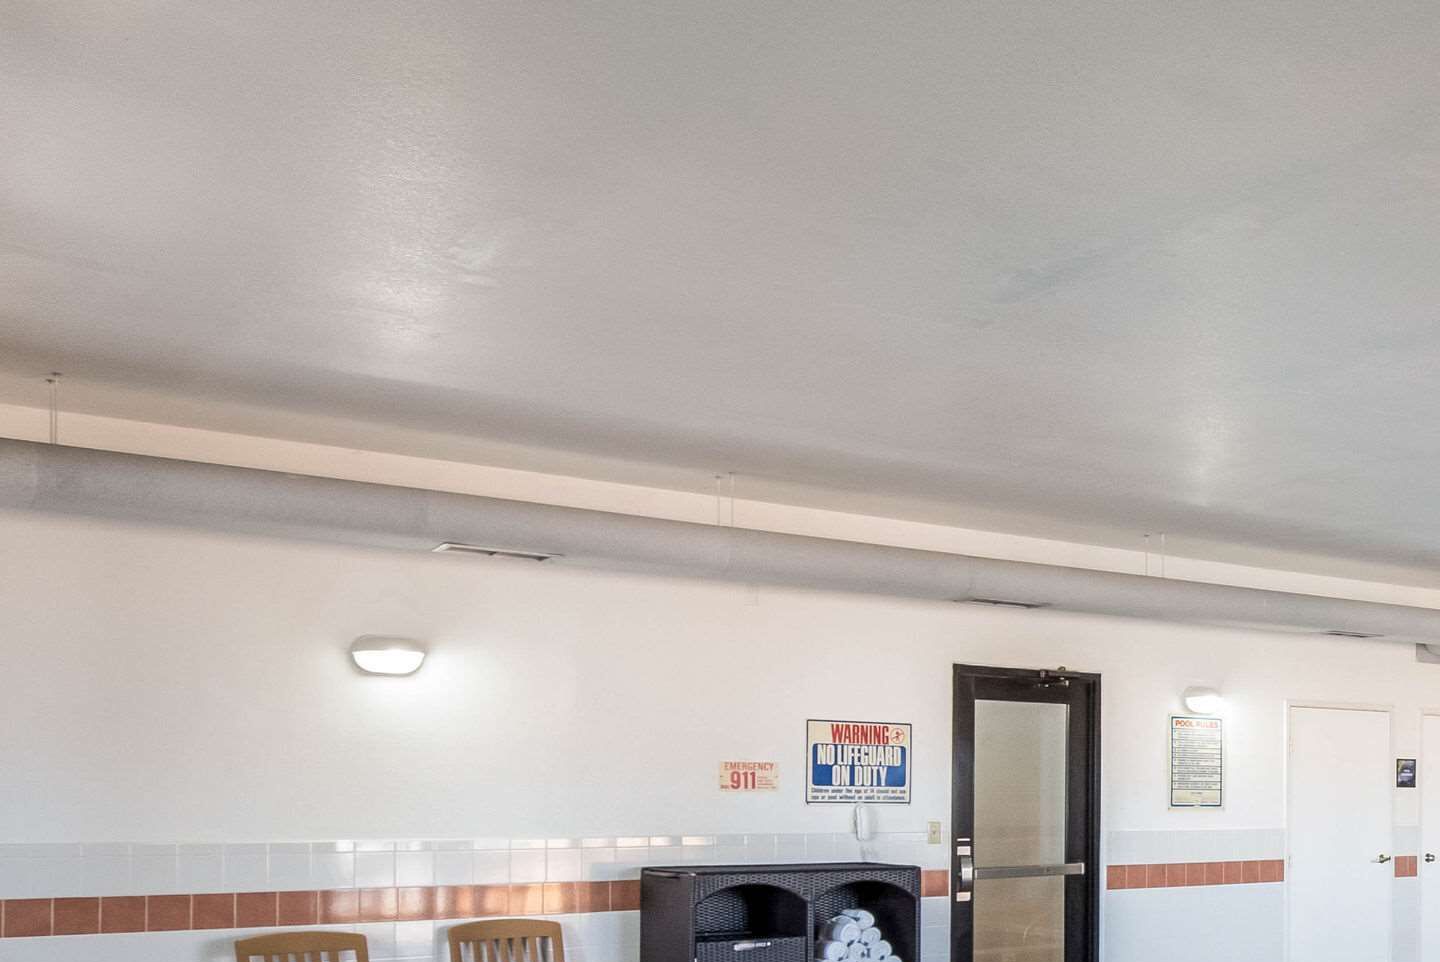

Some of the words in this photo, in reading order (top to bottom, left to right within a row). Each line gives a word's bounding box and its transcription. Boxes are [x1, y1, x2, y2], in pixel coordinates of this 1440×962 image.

[831, 723, 889, 745] WARNING
[817, 744, 835, 765] NO
[837, 744, 901, 767] LIFEGUARD
[731, 771, 756, 790] 911
[832, 765, 851, 786] ON
[854, 765, 888, 787] DUTY
